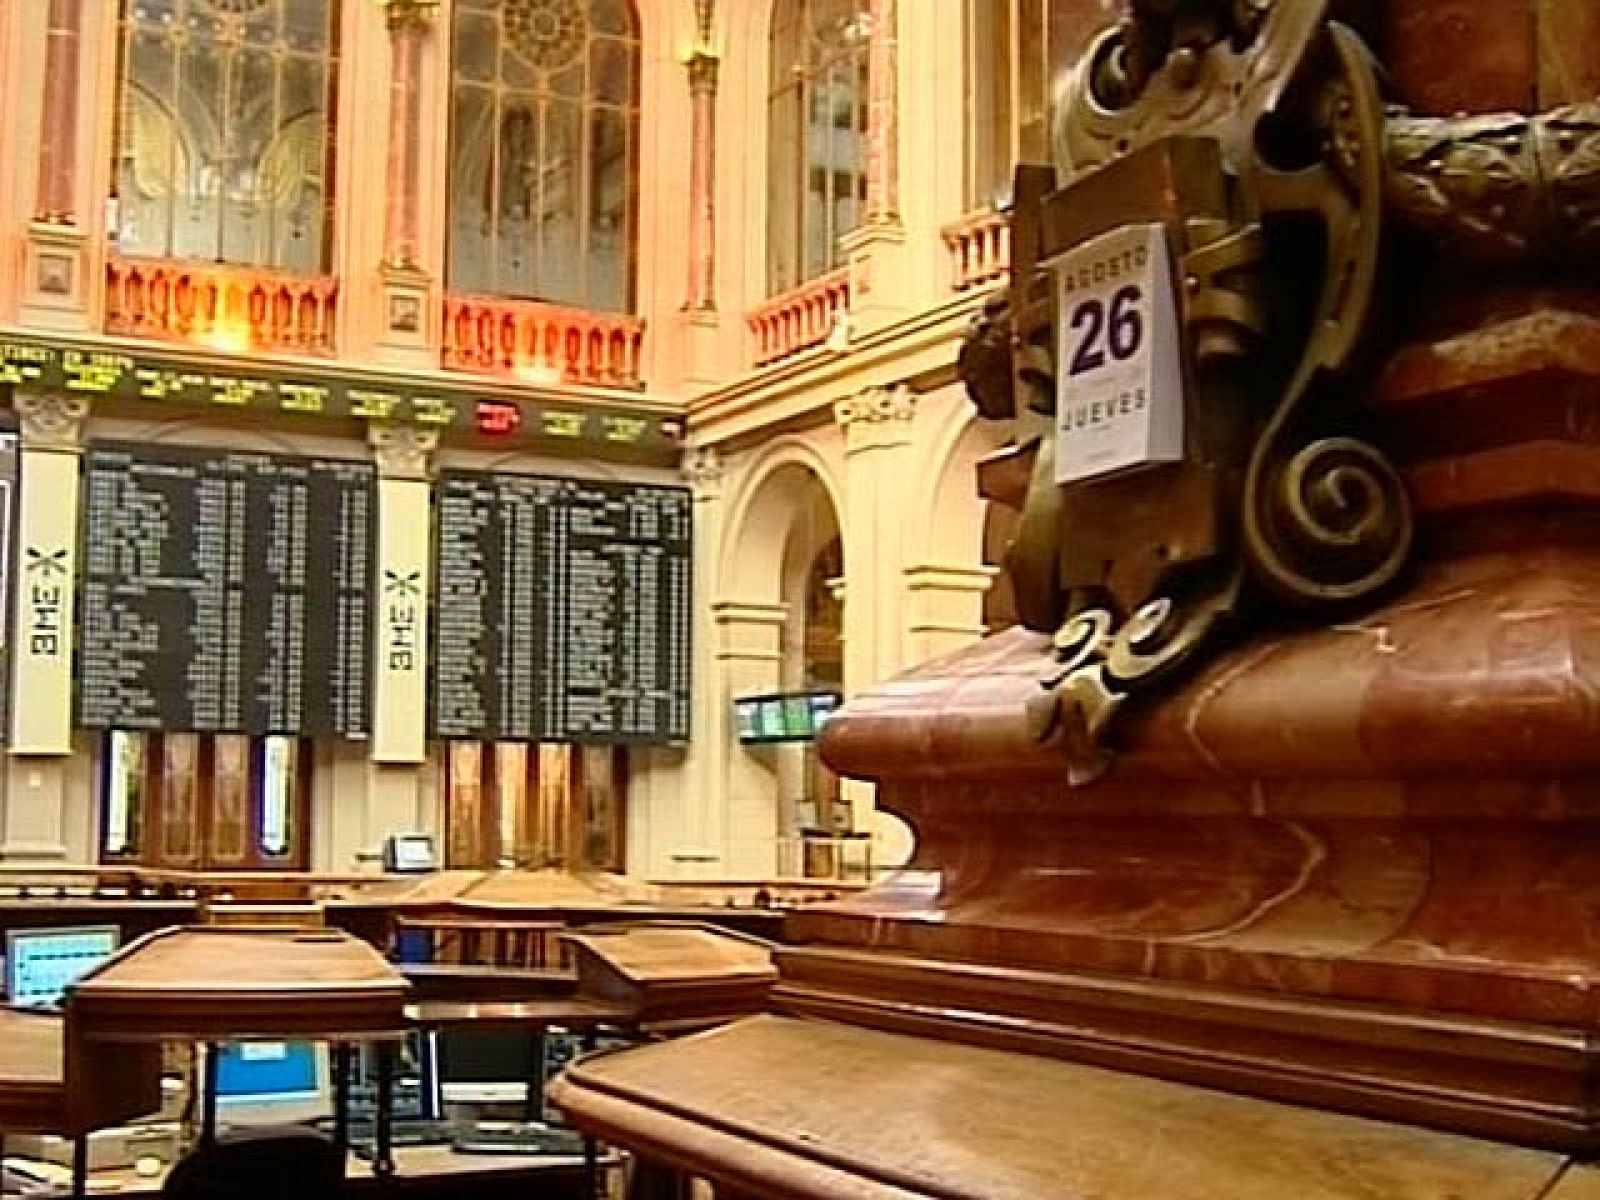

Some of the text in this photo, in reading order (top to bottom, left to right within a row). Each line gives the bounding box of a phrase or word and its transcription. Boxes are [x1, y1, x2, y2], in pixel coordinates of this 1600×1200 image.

[1064, 244, 1146, 291] AGOSTO
[1068, 285, 1143, 376] 26
[1061, 388, 1145, 431] JUEVES
